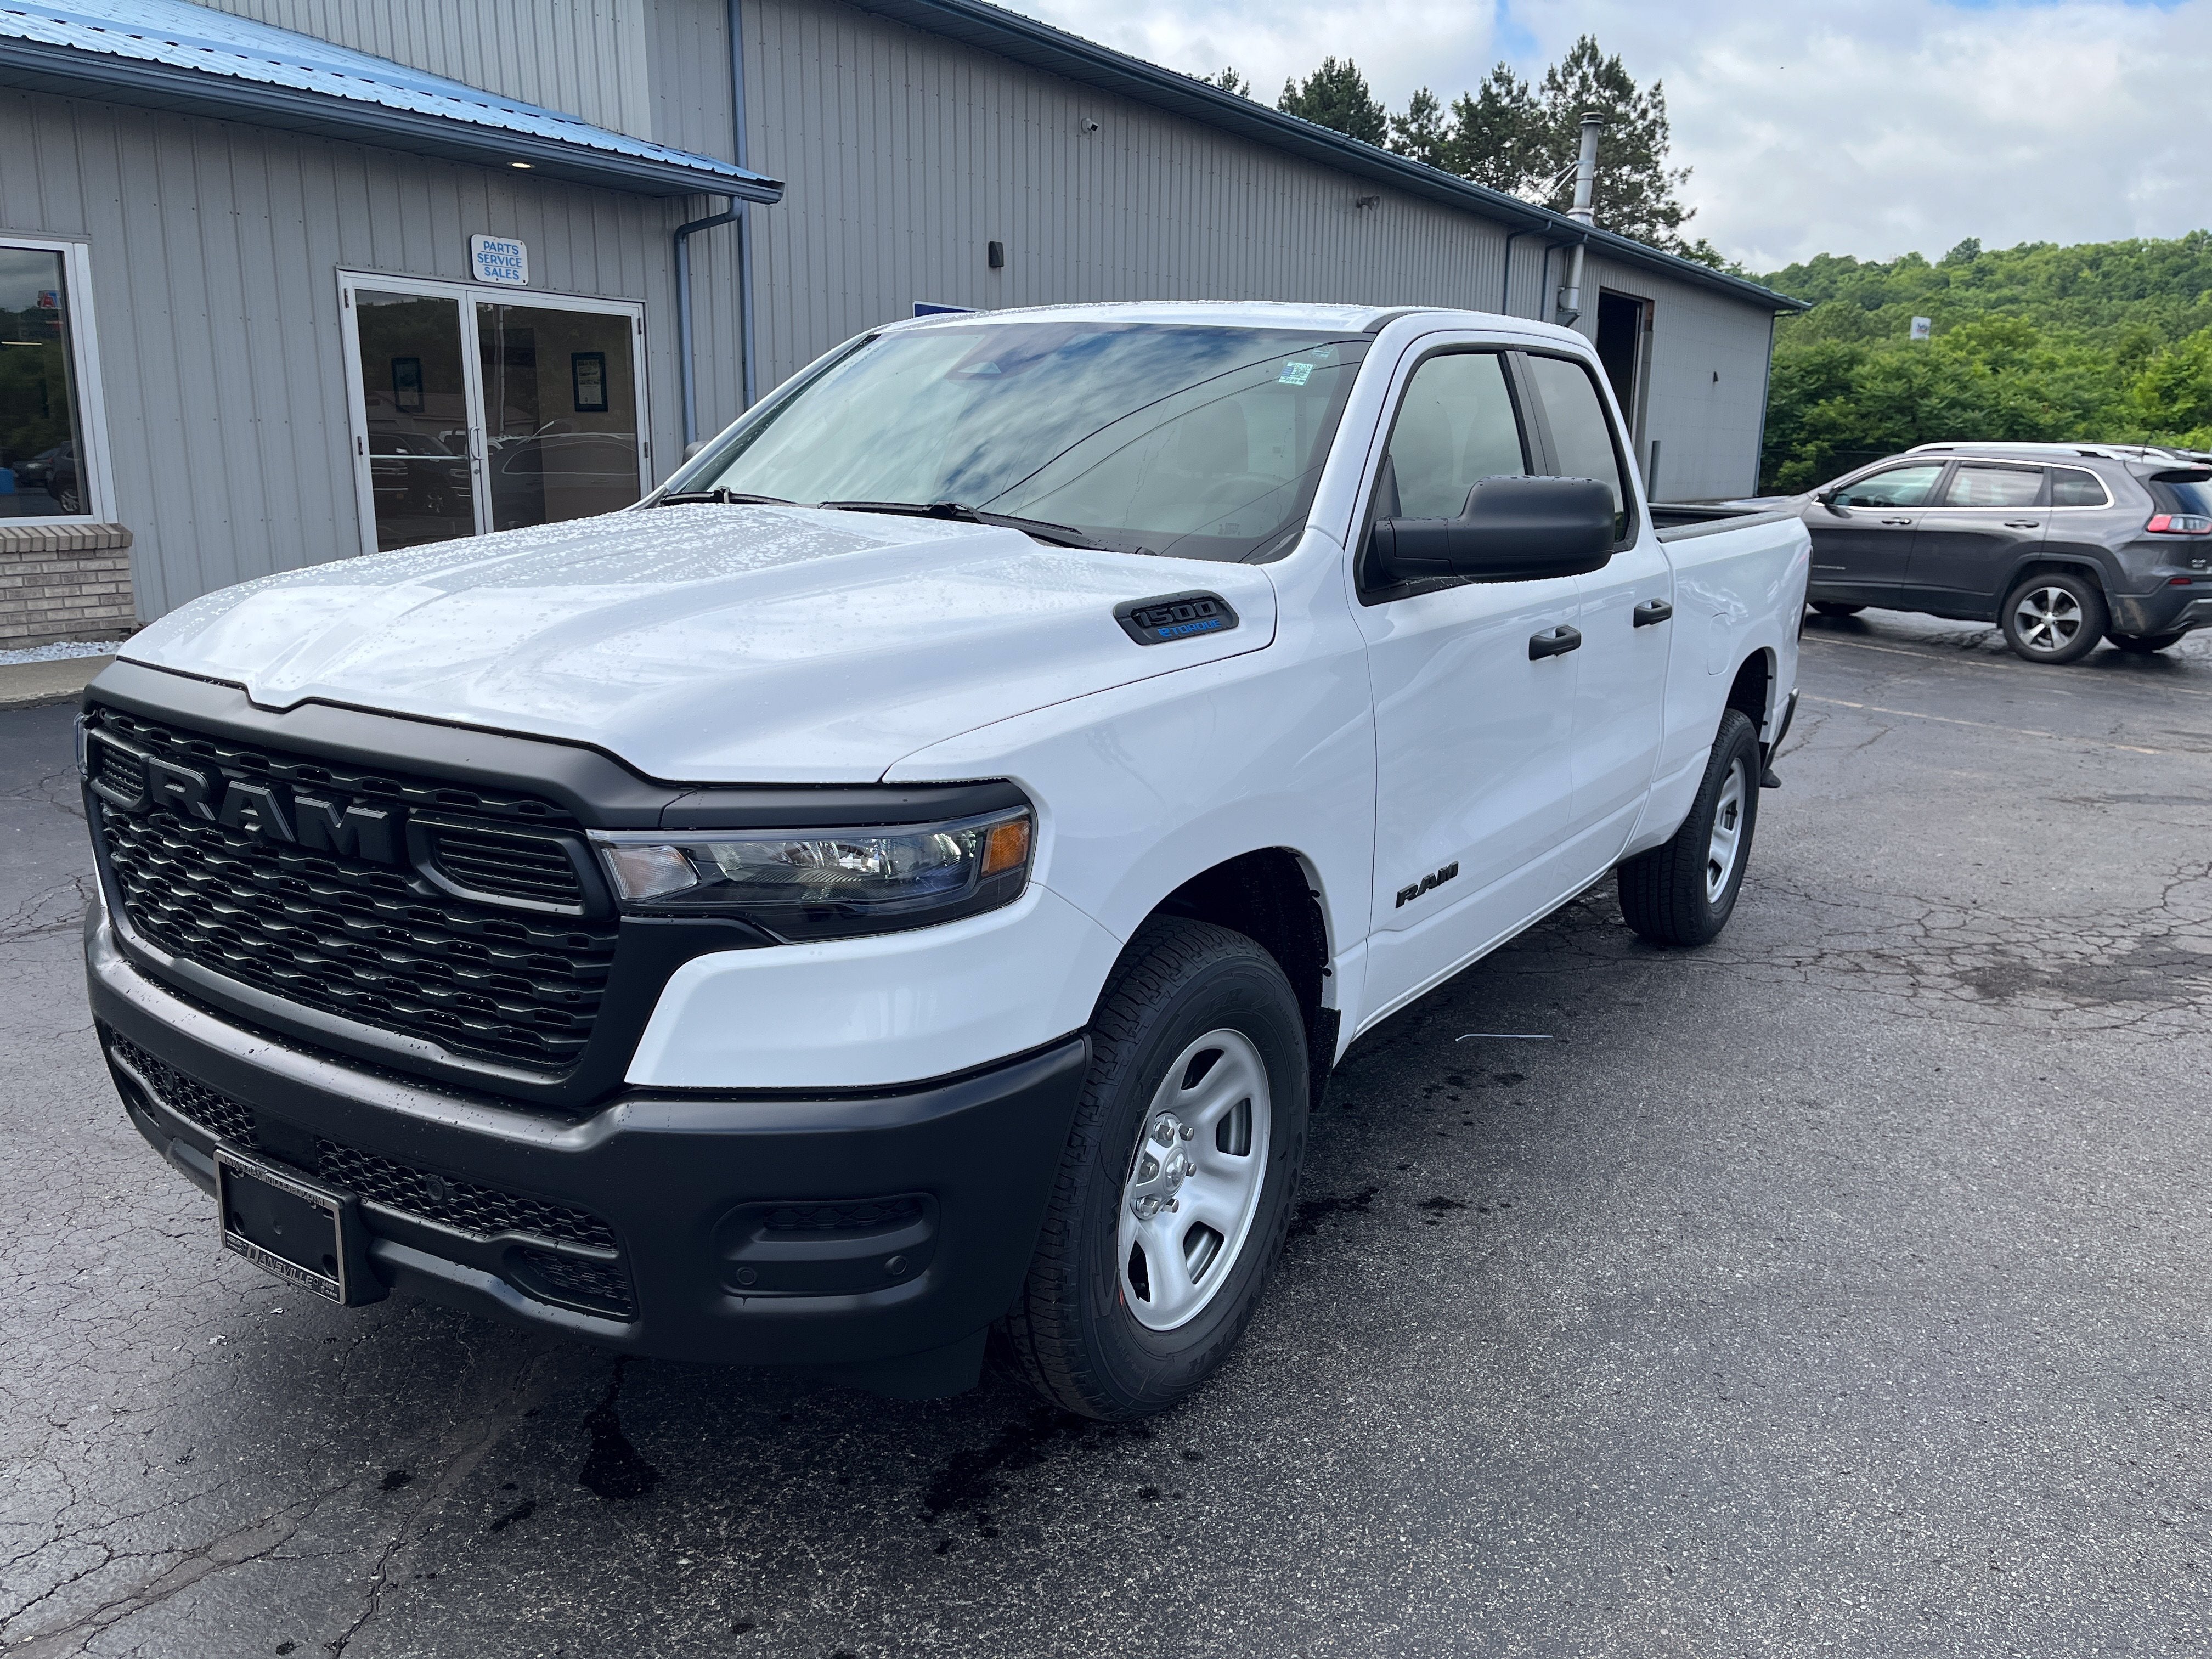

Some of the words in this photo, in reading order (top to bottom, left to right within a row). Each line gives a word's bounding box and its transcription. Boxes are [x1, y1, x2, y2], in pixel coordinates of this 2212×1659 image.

[477, 253, 522, 268] SERVICE
[483, 241, 518, 255] PARTS
[484, 267, 519, 280] SALES
[1136, 600, 1217, 627] 1500
[149, 757, 387, 865] RAM
[1395, 860, 1459, 909] RAM
[247, 1244, 313, 1288] DANSVILLE
[1187, 1131, 1304, 1374] GOODYEAR
